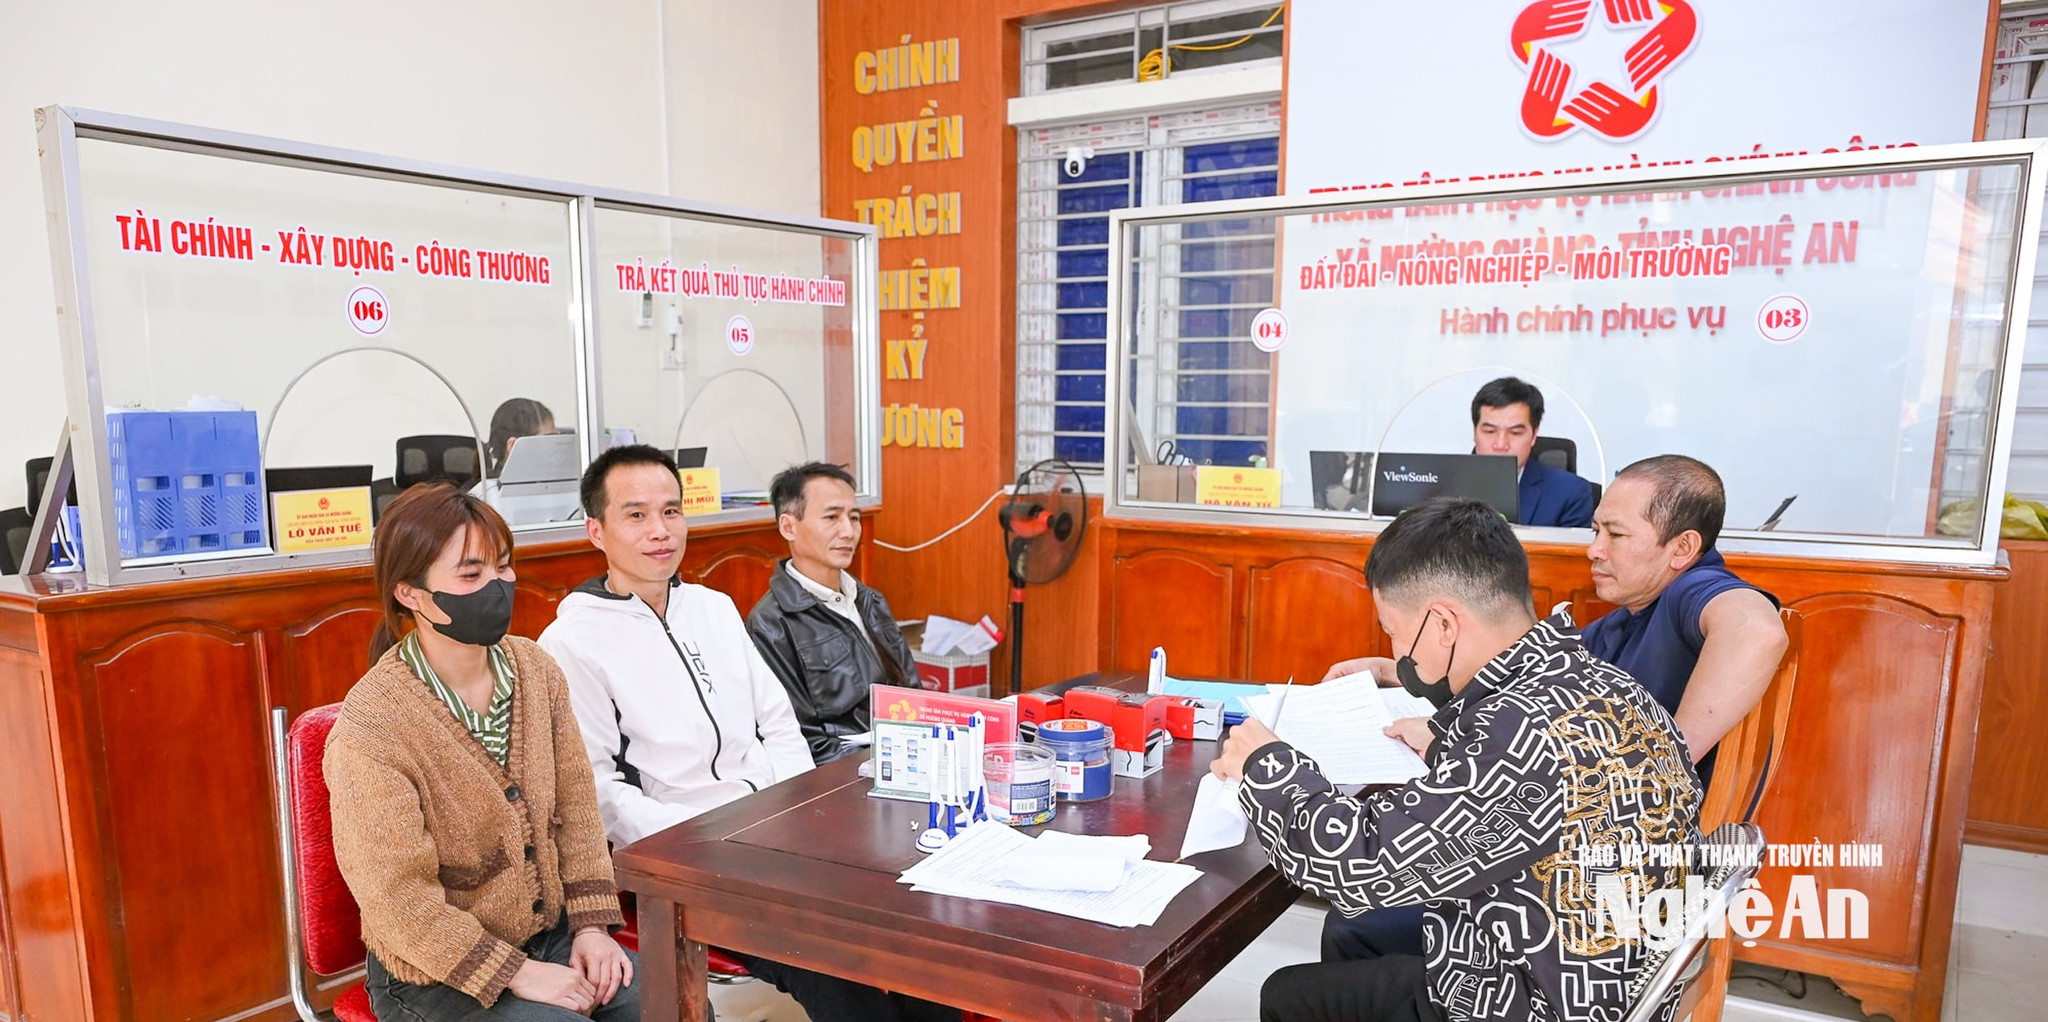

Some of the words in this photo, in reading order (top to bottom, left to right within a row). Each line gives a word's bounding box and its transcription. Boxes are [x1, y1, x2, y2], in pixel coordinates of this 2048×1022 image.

[854, 34, 959, 94] CHÍNH
[852, 100, 963, 172] QUYỀN
[853, 185, 961, 238] TRÁCH
[115, 210, 162, 252] TÀI
[170, 217, 253, 260] CHÍNH
[279, 228, 324, 265] XÂY
[334, 237, 395, 275] DỰNG
[417, 241, 471, 278] CÔNG
[477, 251, 550, 285] THƯƠNG
[1803, 221, 1859, 264] AN
[616, 258, 645, 291] TRẢ
[651, 261, 676, 293] KẾT
[682, 263, 709, 296] QUẢ
[714, 266, 739, 297] THỦ
[743, 275, 767, 304] TỤC
[772, 273, 805, 301] HÀNH
[809, 276, 844, 305] CHÍNH
[879, 258, 960, 319] HIỆM
[1300, 256, 1338, 290] ĐẤT
[1343, 263, 1376, 288] ĐAI
[1399, 255, 1458, 286] NÔNG
[1466, 250, 1549, 288] NGHIỆP
[1574, 246, 1621, 280] MÔI
[1629, 243, 1730, 278] TRƯỜNG
[354, 300, 383, 321] 06
[1259, 322, 1283, 338] 04
[1440, 306, 1509, 335] Hành
[1516, 304, 1593, 333] chính
[1601, 302, 1676, 337] phục
[1688, 306, 1726, 336] vụ
[1765, 308, 1802, 329] 03
[731, 328, 748, 343] 05
[886, 324, 927, 379] KỶ
[881, 403, 964, 448] ƯƠNG
[1383, 471, 1438, 483] ViewSonic
